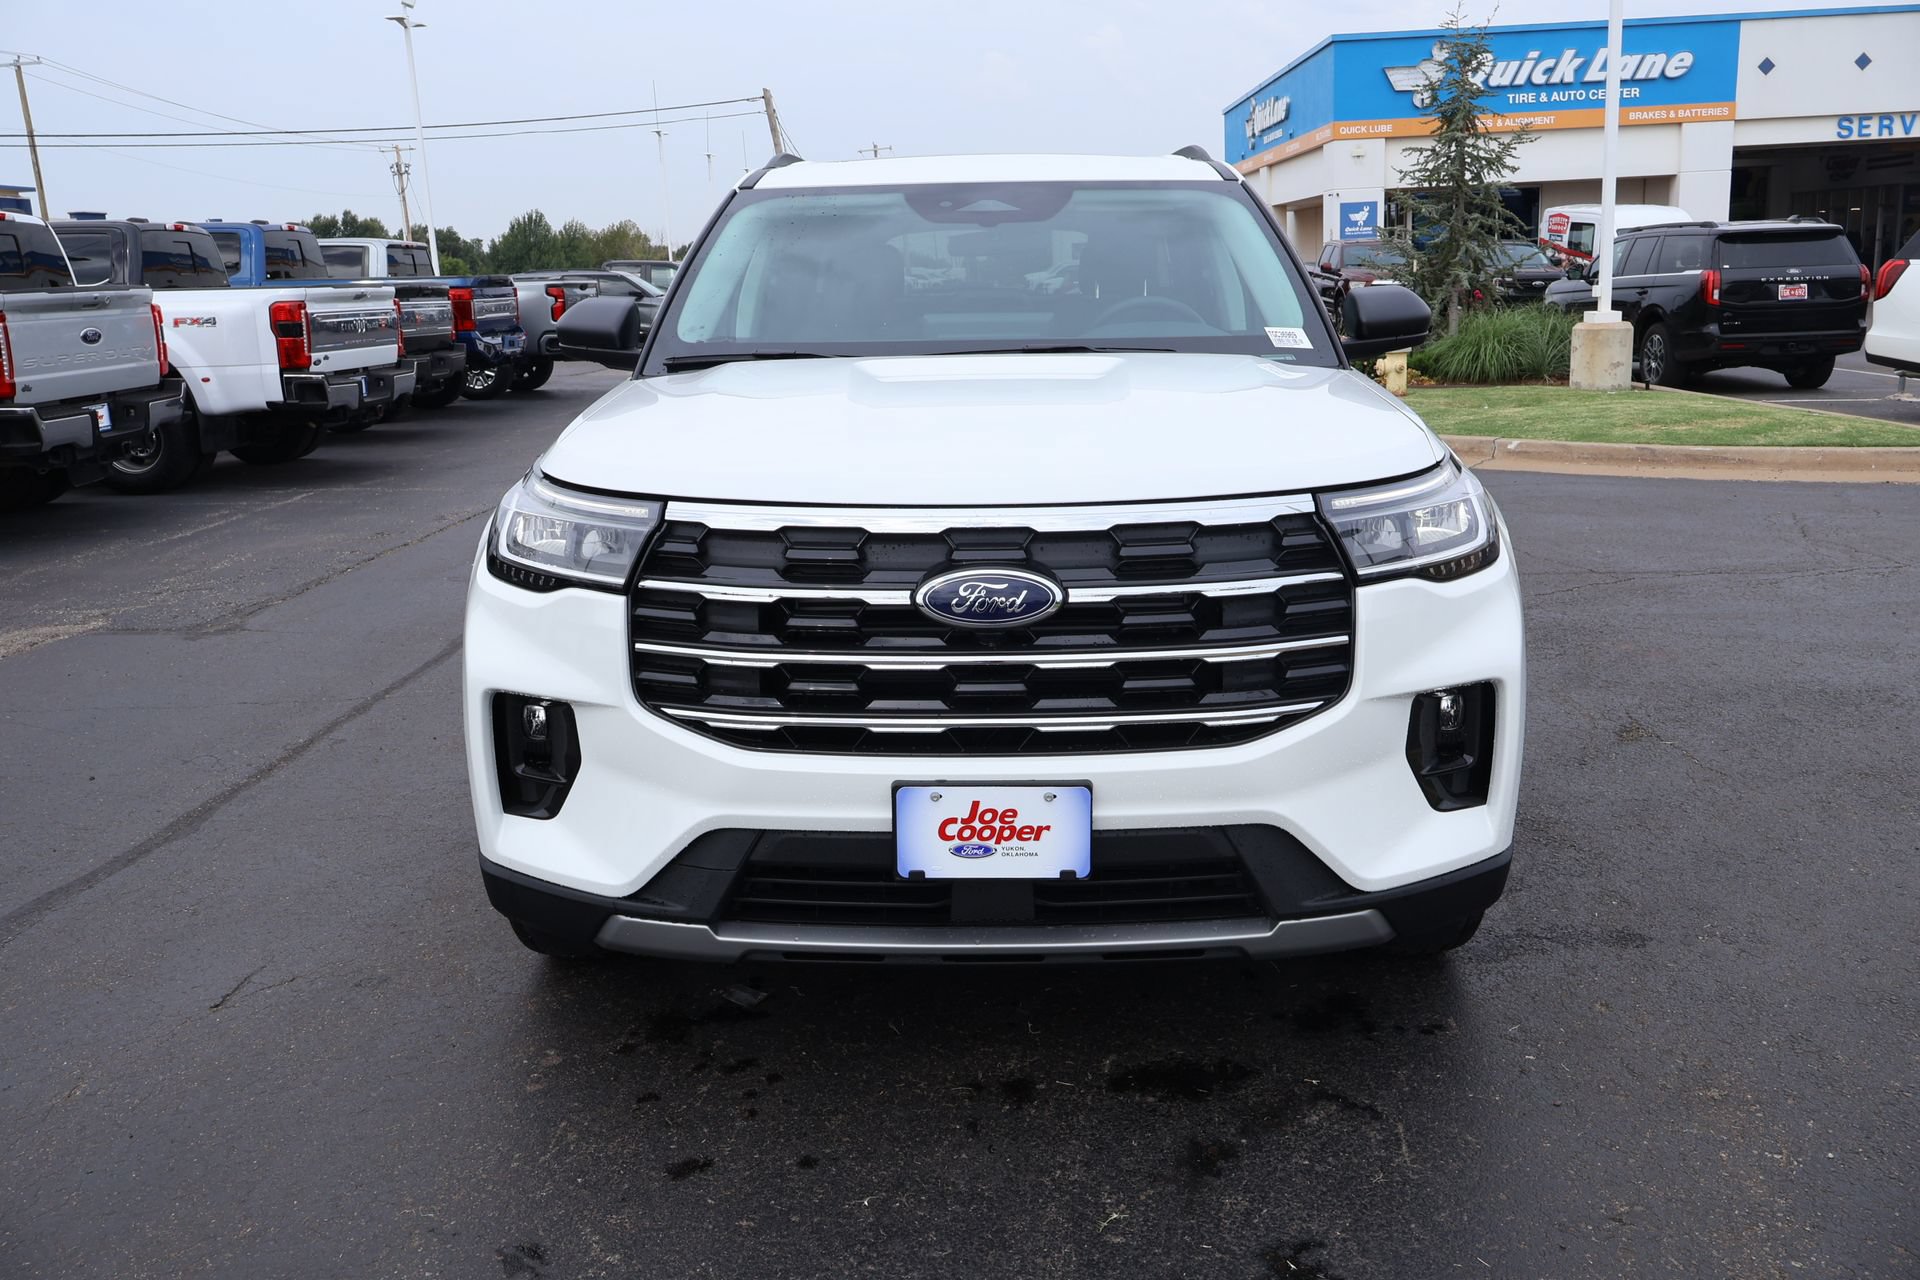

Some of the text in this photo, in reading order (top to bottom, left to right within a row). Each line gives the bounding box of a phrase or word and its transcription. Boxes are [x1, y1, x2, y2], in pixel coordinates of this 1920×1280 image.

[1507, 93, 1536, 104] TIRE
[1540, 91, 1548, 102] &
[1551, 90, 1586, 101] AUTO
[1496, 118, 1503, 127] &
[1504, 115, 1556, 127] ALIGNMENT
[1629, 107, 1729, 120] BRAKES & BATTERIES
[1339, 125, 1368, 135] QUICK
[1369, 124, 1393, 133] LUBE
[1836, 113, 1918, 139] SERV
[173, 316, 217, 328] FX4
[23, 345, 153, 370] SUPER DUTY
[951, 581, 1028, 614] Ford
[960, 800, 1018, 825] Joe
[937, 816, 1051, 845] Cooper
